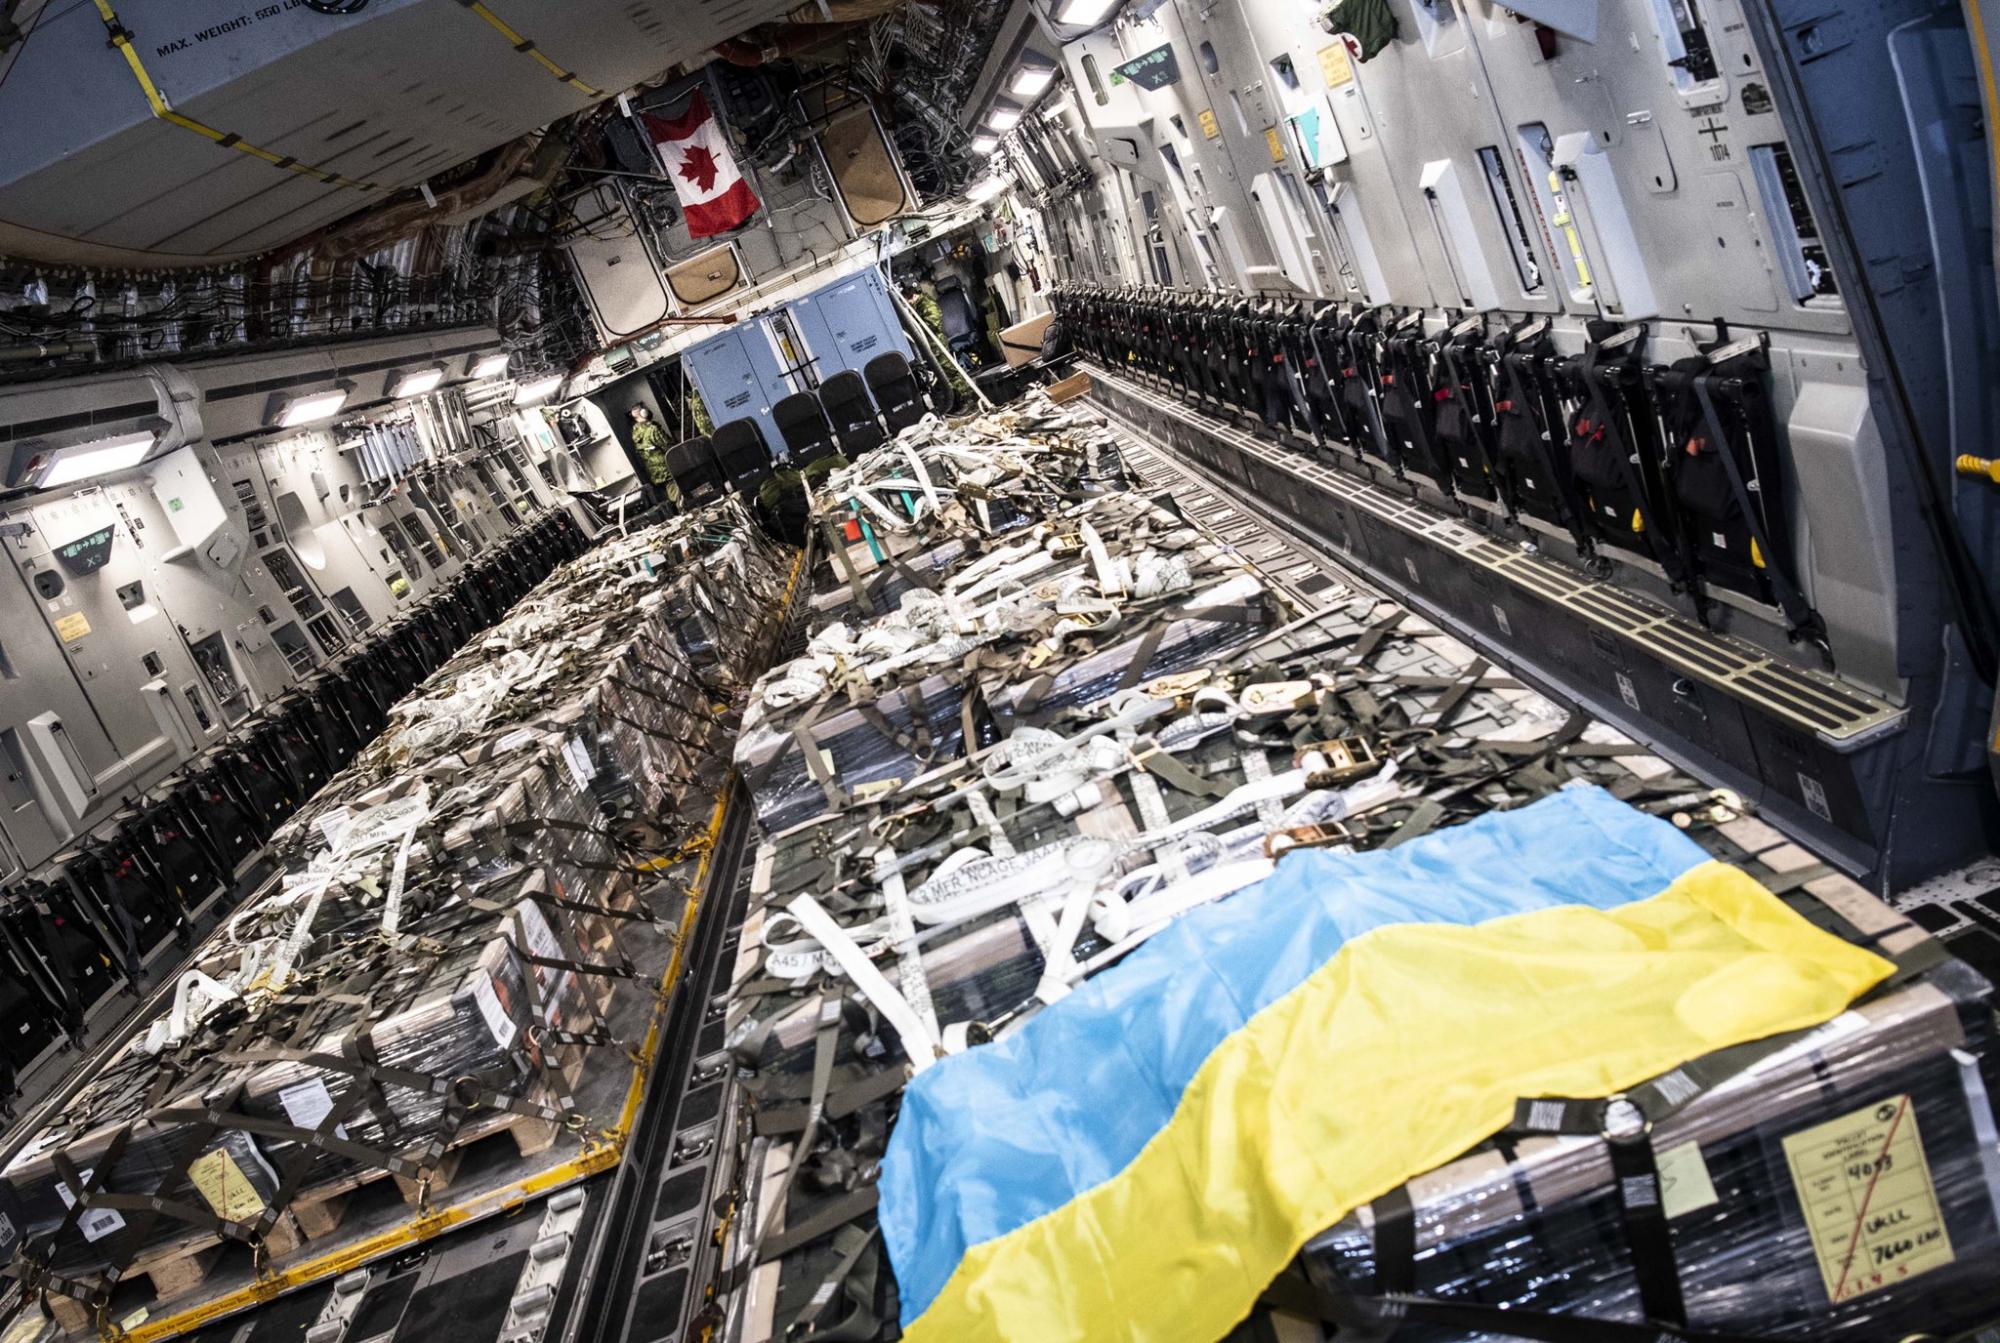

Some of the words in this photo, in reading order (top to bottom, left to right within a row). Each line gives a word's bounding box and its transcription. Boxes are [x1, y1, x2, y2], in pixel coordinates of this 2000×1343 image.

[156, 38, 193, 58] MAX.
[194, 15, 253, 43] WEIGHT:
[255, 4, 281, 20] 550
[1710, 144, 1732, 161] 1074
[966, 858, 1017, 885] NCAGE
